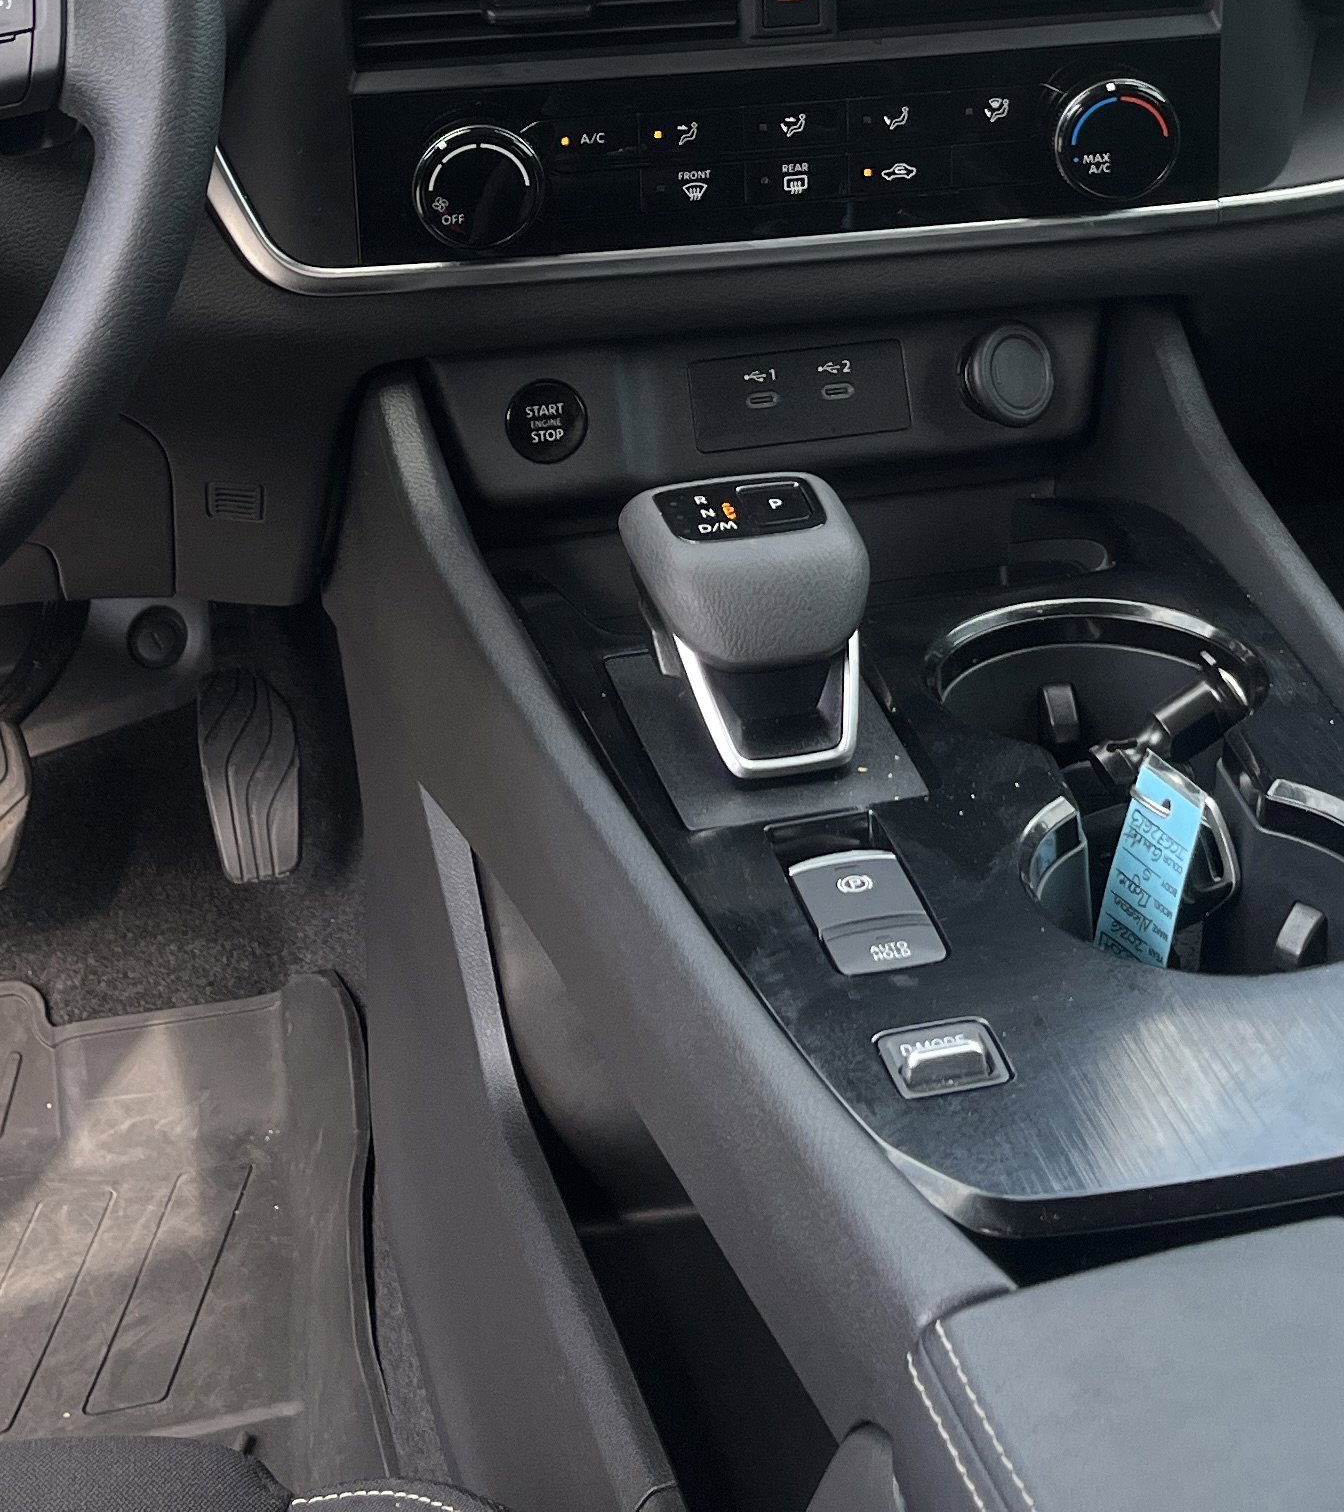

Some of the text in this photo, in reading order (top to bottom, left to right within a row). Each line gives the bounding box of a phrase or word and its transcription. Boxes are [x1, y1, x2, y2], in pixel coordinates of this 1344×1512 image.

[580, 132, 606, 146] A/C
[1082, 152, 1111, 164] MAX
[782, 162, 808, 173] REAR
[1088, 162, 1112, 174] A/C
[678, 170, 711, 182] FRONT
[441, 214, 465, 226] OFF
[842, 360, 851, 373] 2
[768, 368, 776, 380] 1
[525, 402, 564, 418] START
[530, 418, 562, 429] ENGINE
[531, 428, 564, 443] STOP
[694, 495, 708, 505] R
[768, 498, 784, 510] P
[700, 508, 716, 518] N
[698, 520, 738, 534] D/M
[1142, 868, 1151, 881] S
[870, 940, 908, 954] AUTO
[872, 948, 911, 961] HOLD
